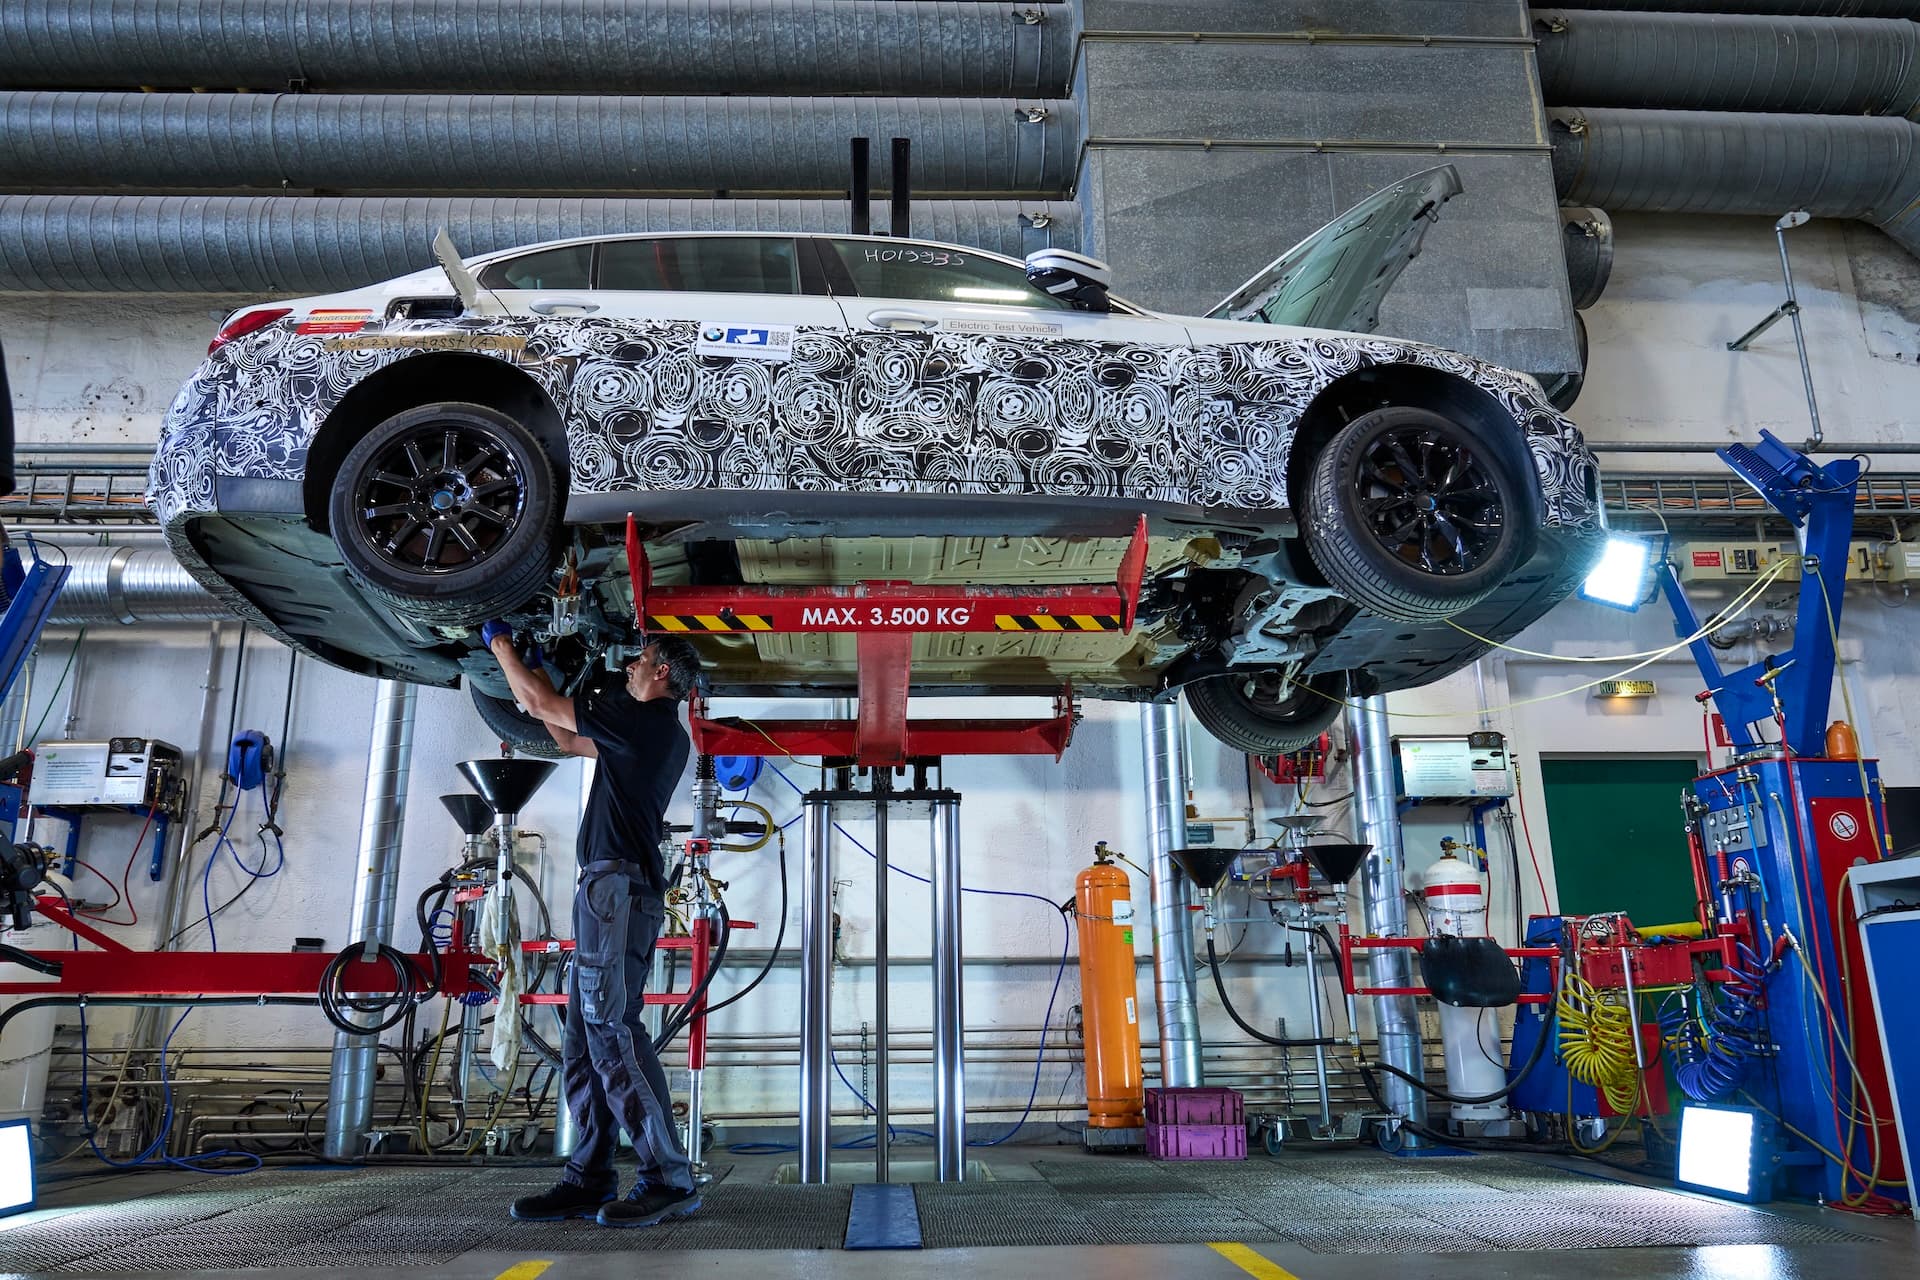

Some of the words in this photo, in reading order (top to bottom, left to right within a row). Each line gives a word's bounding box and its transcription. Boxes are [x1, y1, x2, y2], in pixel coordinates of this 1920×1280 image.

[950, 320, 990, 330] Electric
[993, 322, 1015, 331] Test
[1018, 324, 1057, 333] Vehicle
[801, 607, 863, 625] MAX.
[869, 607, 930, 625] 3.500
[936, 607, 970, 625] KG
[1600, 680, 1654, 694] NOTAUSGANG
